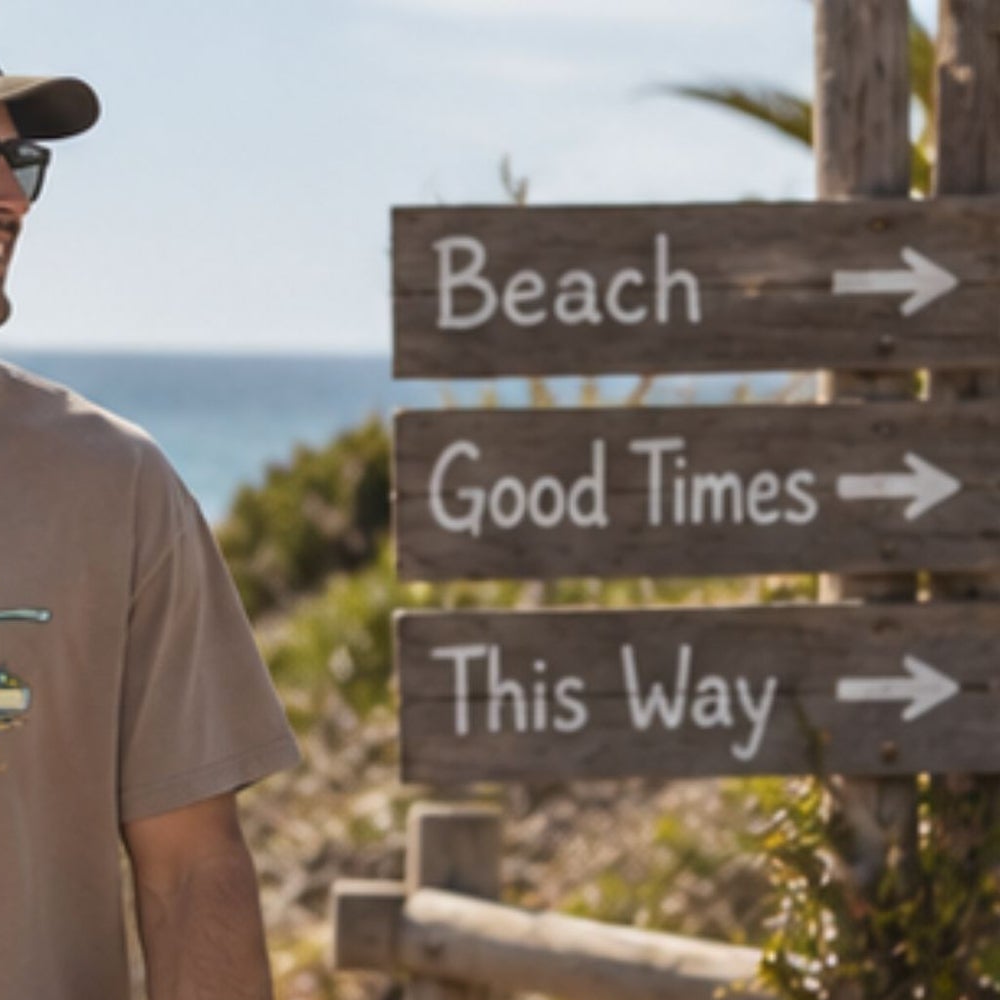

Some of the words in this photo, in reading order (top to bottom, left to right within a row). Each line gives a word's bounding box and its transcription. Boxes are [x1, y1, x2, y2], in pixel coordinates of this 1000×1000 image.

[434, 233, 702, 329] Beach
[429, 439, 608, 536] Good
[630, 438, 819, 526] Times
[431, 644, 588, 736] This
[621, 644, 777, 761] Way
